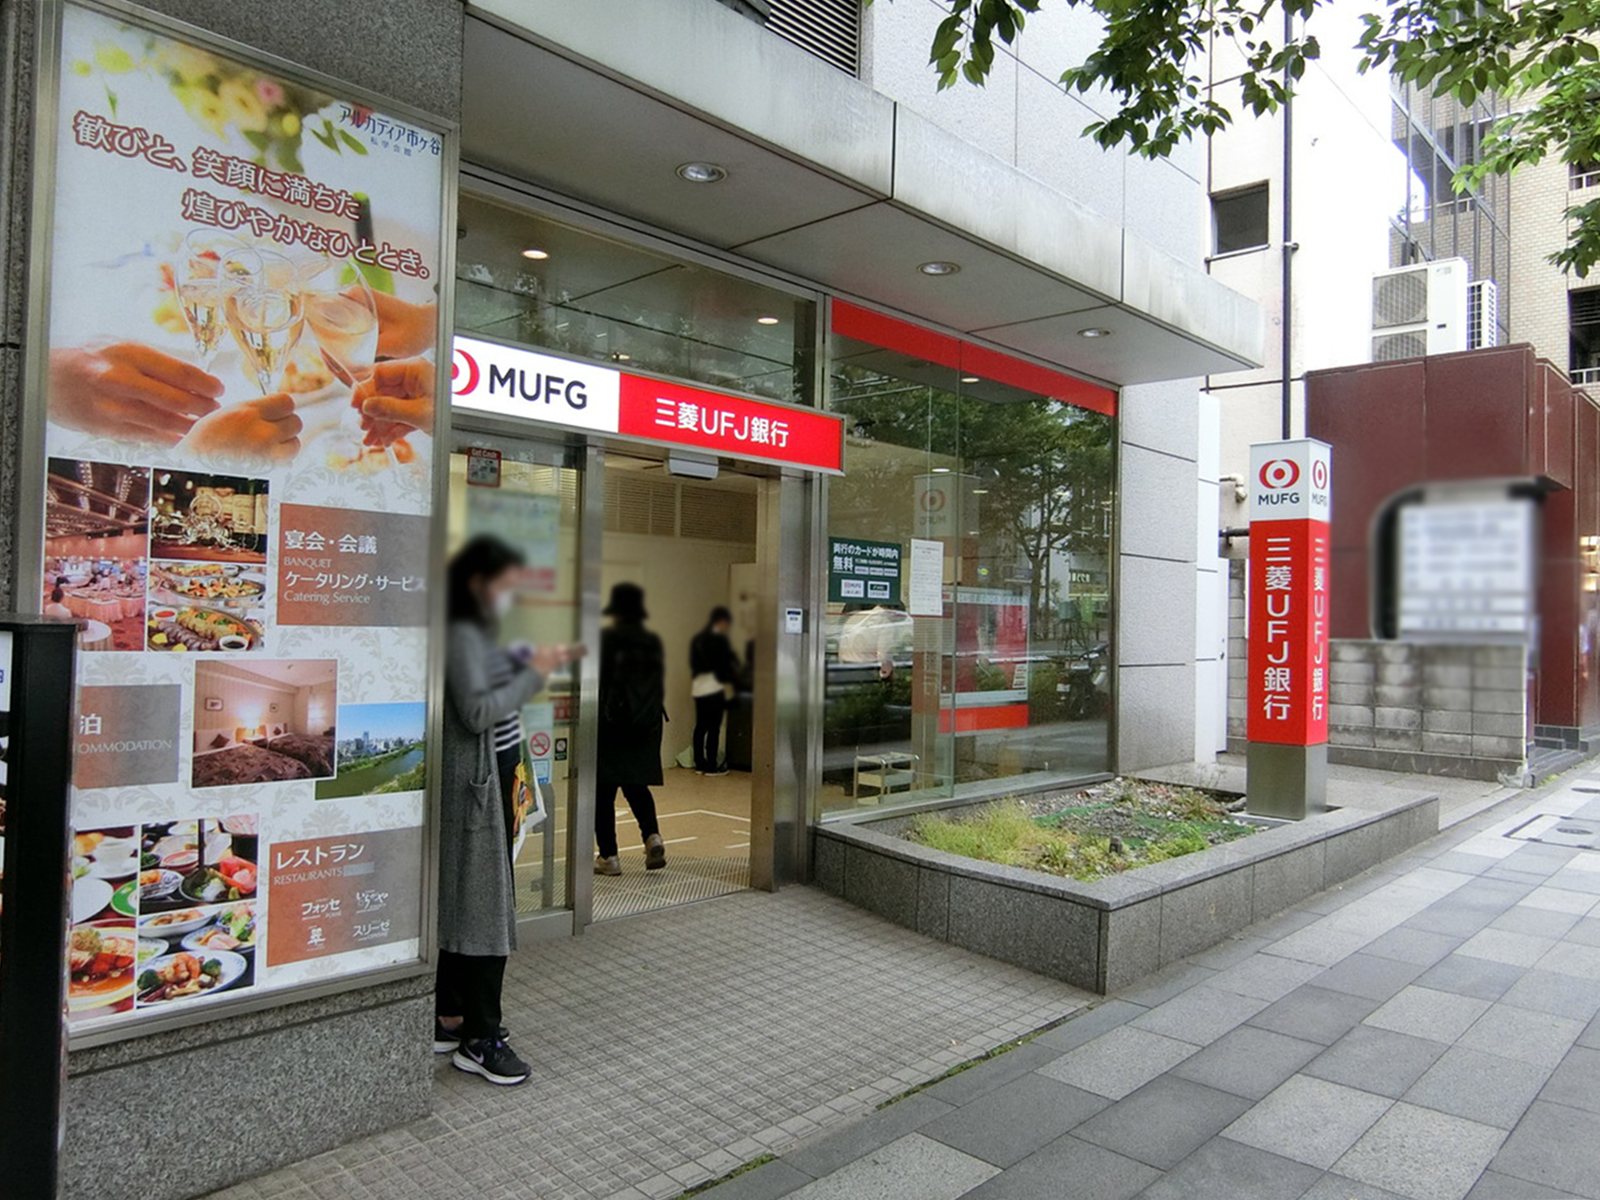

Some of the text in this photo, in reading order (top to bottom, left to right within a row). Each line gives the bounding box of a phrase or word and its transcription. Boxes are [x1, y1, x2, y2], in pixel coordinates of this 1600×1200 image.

[73, 110, 361, 221] 歓びと、笑顔に満ちた
[181, 188, 430, 279] 煌びやかなひととき。
[488, 364, 587, 409] MUFG
[654, 398, 789, 448] 三菱UFJ銀行
[1258, 492, 1300, 505] MUFG
[284, 530, 377, 554] 宴会・会議
[284, 556, 332, 569] BANQUET
[833, 555, 853, 571] 無料
[285, 571, 426, 592] ケータリング・サービス
[284, 590, 370, 605] Catering Service
[1263, 537, 1292, 720] 三菱UFJ銀行
[1312, 537, 1325, 720] 三菱UFJ銀行
[79, 713, 102, 735] 泊
[276, 843, 365, 869] レストラン
[274, 867, 343, 885] RESTAURANTS
[301, 898, 341, 915] フォンセ
